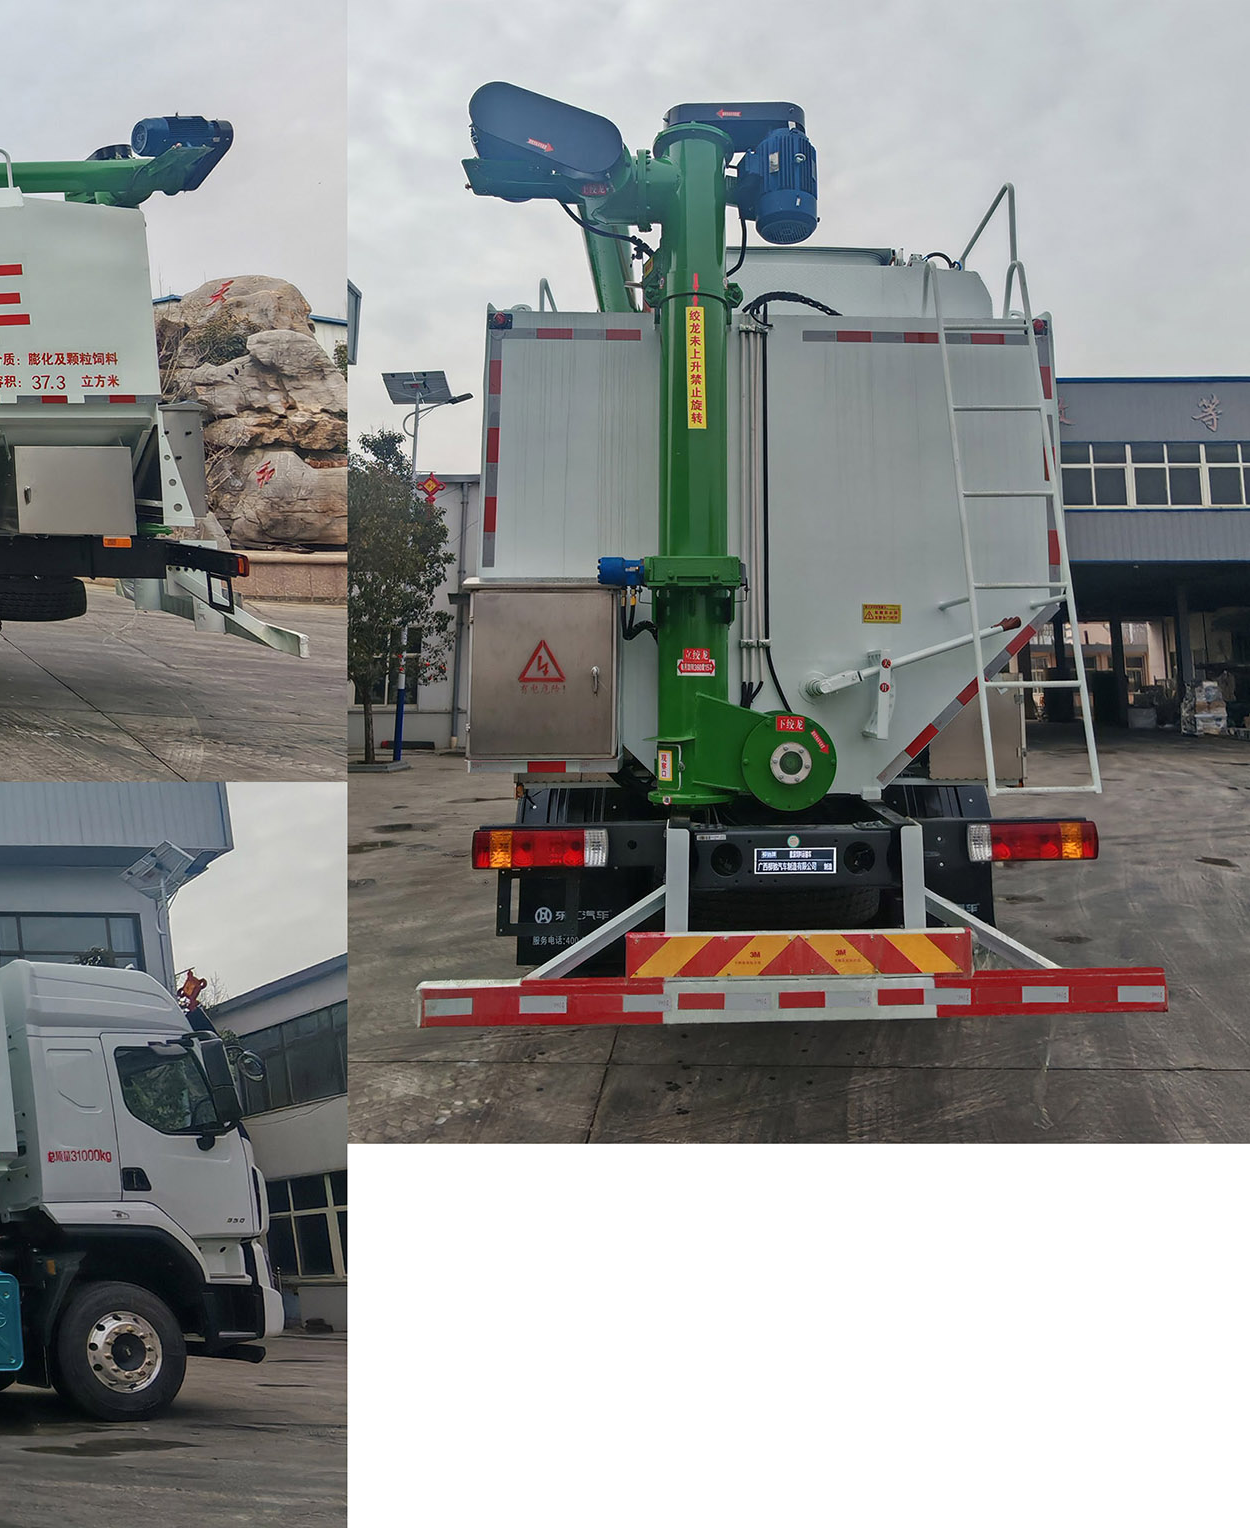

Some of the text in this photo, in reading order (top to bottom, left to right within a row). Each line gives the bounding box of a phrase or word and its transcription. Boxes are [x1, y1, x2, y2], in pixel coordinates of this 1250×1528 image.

[689, 310, 703, 424] 绞龙未上升禁止旋转
[31, 375, 66, 390] 37.3
[81, 375, 120, 388] 立方米
[555, 910, 610, 921] 东汽车
